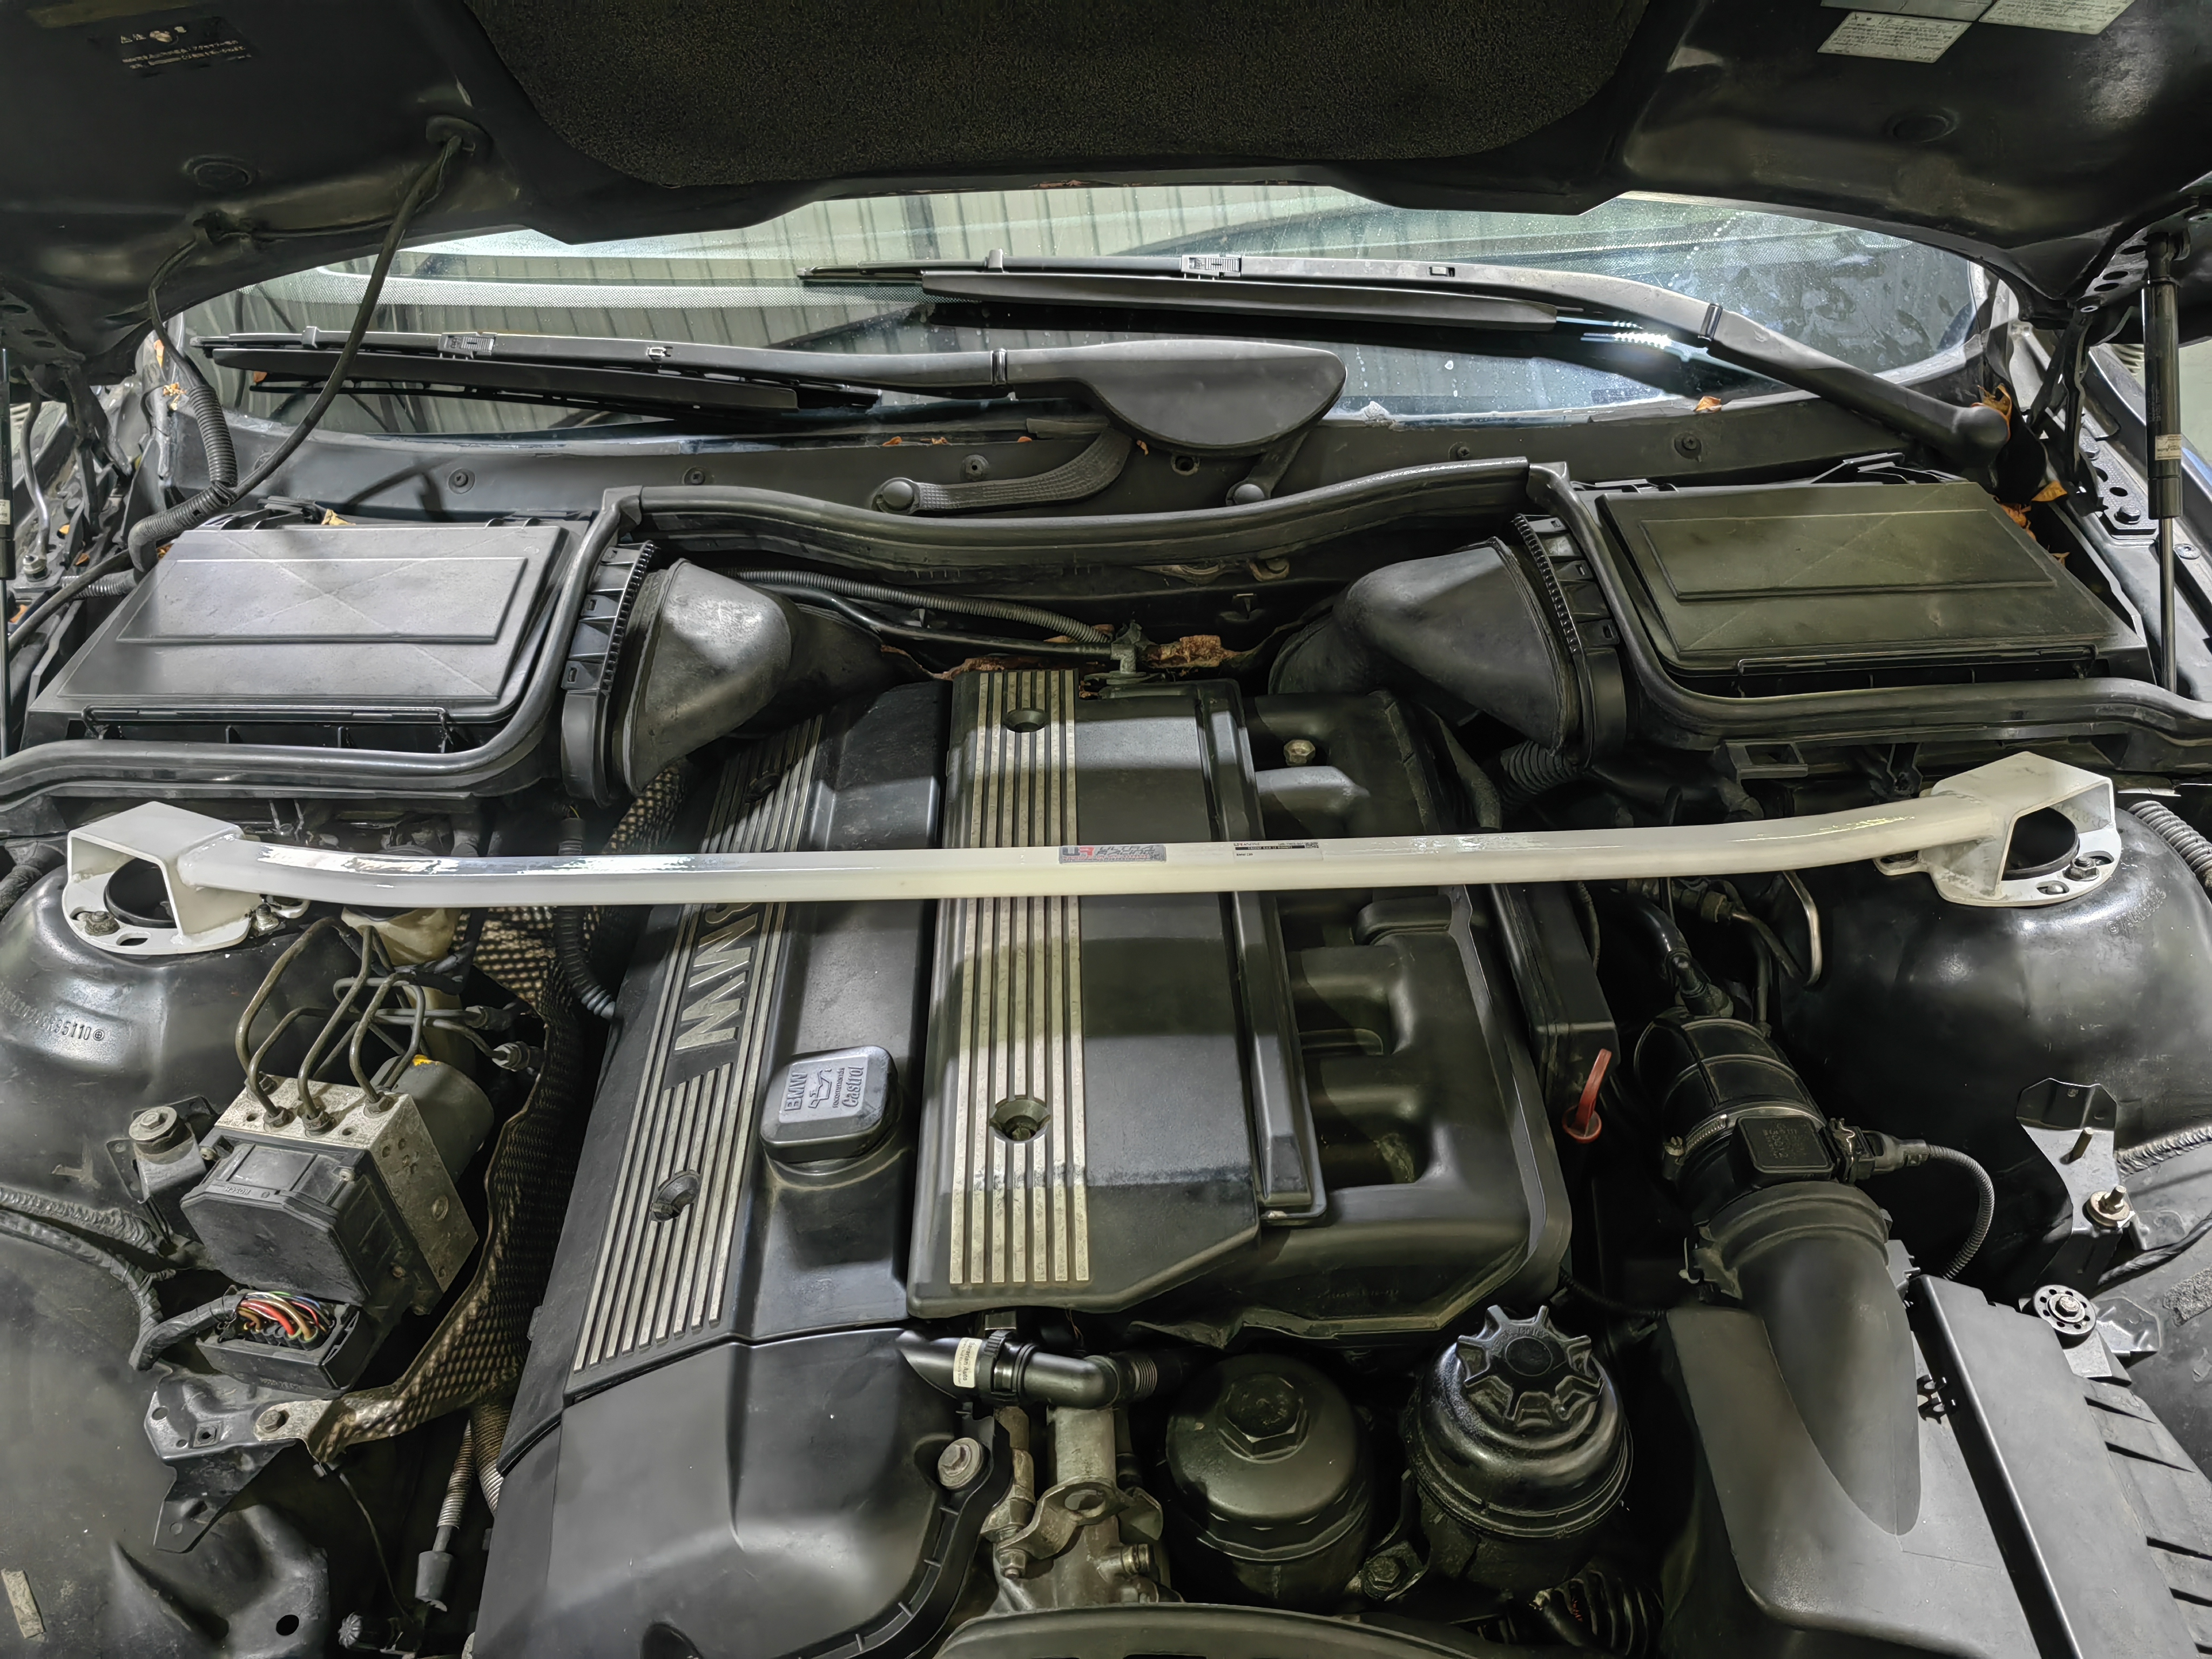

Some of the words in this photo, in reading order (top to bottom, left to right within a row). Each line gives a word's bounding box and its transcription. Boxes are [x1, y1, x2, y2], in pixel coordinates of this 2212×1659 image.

[784, 1071, 808, 1111] BMW
[832, 1067, 844, 1108] recommends
[841, 1065, 864, 1108] Castrol
[963, 1342, 975, 1365] Bavarian
